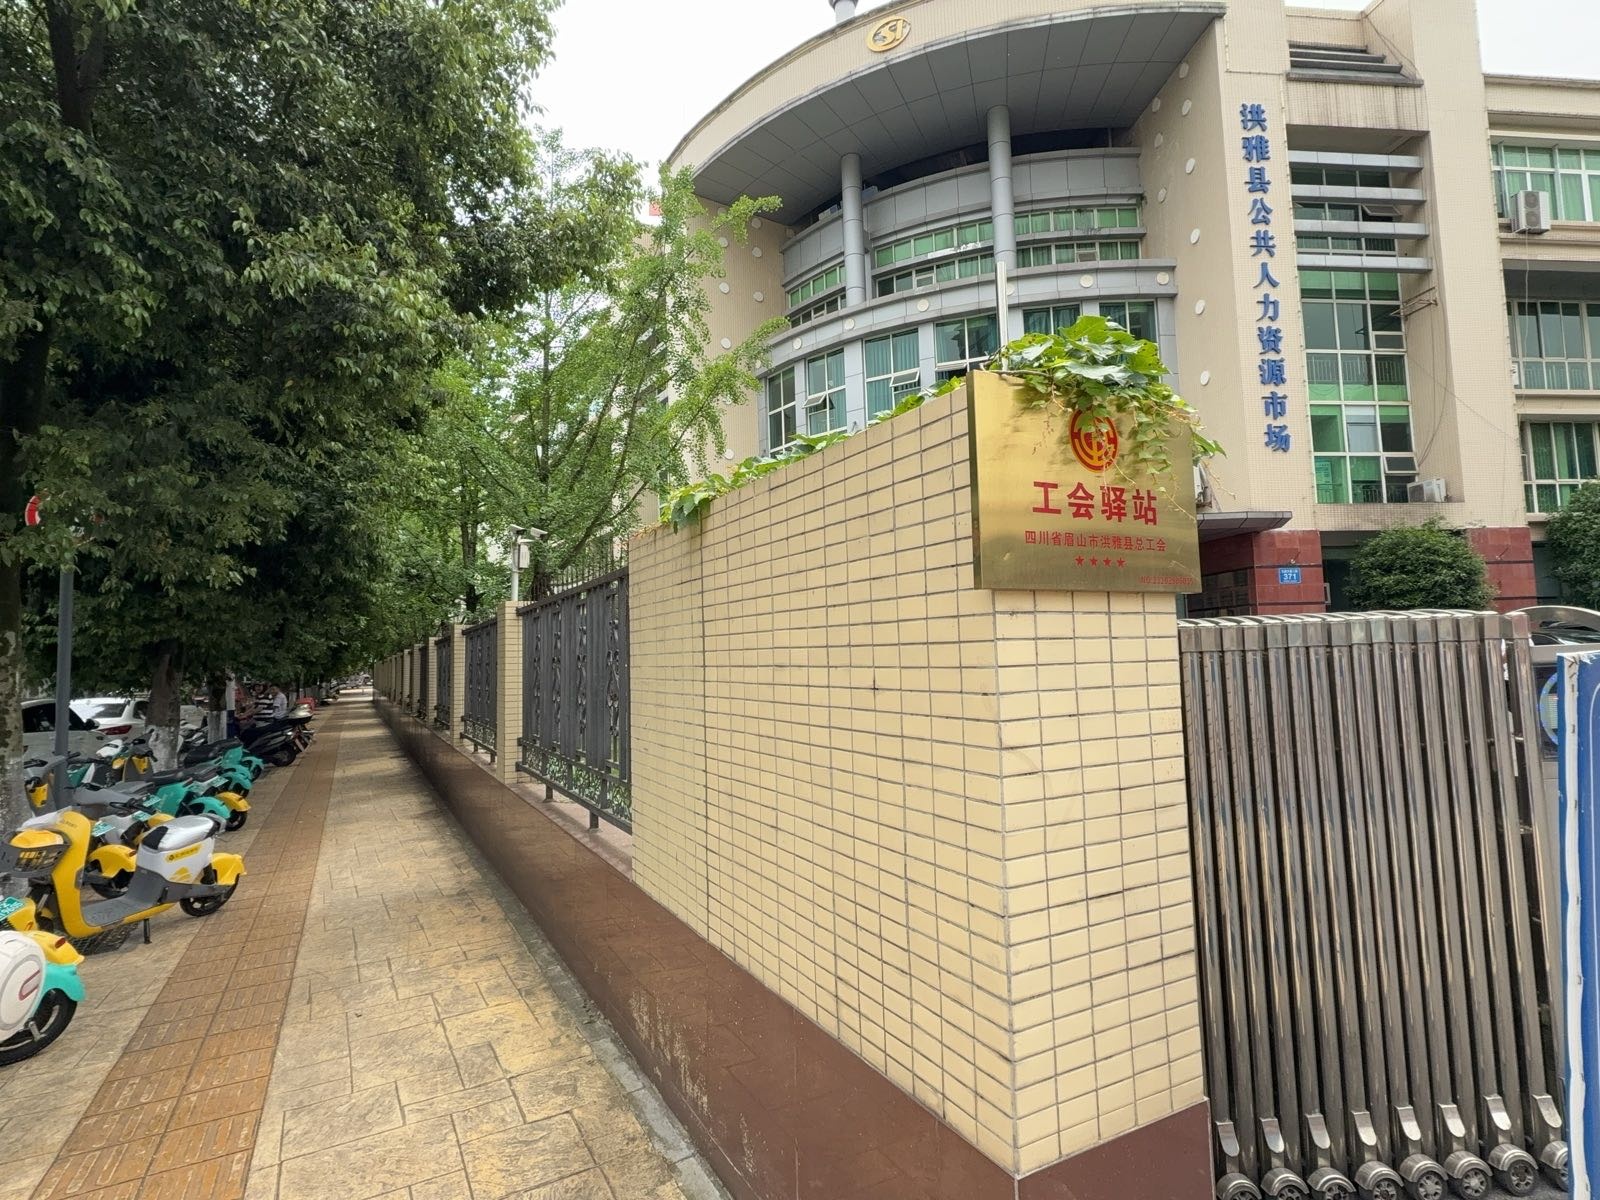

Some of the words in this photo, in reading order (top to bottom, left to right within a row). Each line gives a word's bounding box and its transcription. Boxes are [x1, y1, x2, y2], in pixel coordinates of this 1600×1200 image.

[1240, 103, 1291, 453] 洪雅县公共人力资源市场
[1032, 481, 1158, 525] 工会驿站
[1025, 530, 1166, 552] 四川省眉山市洪雅县总工会
